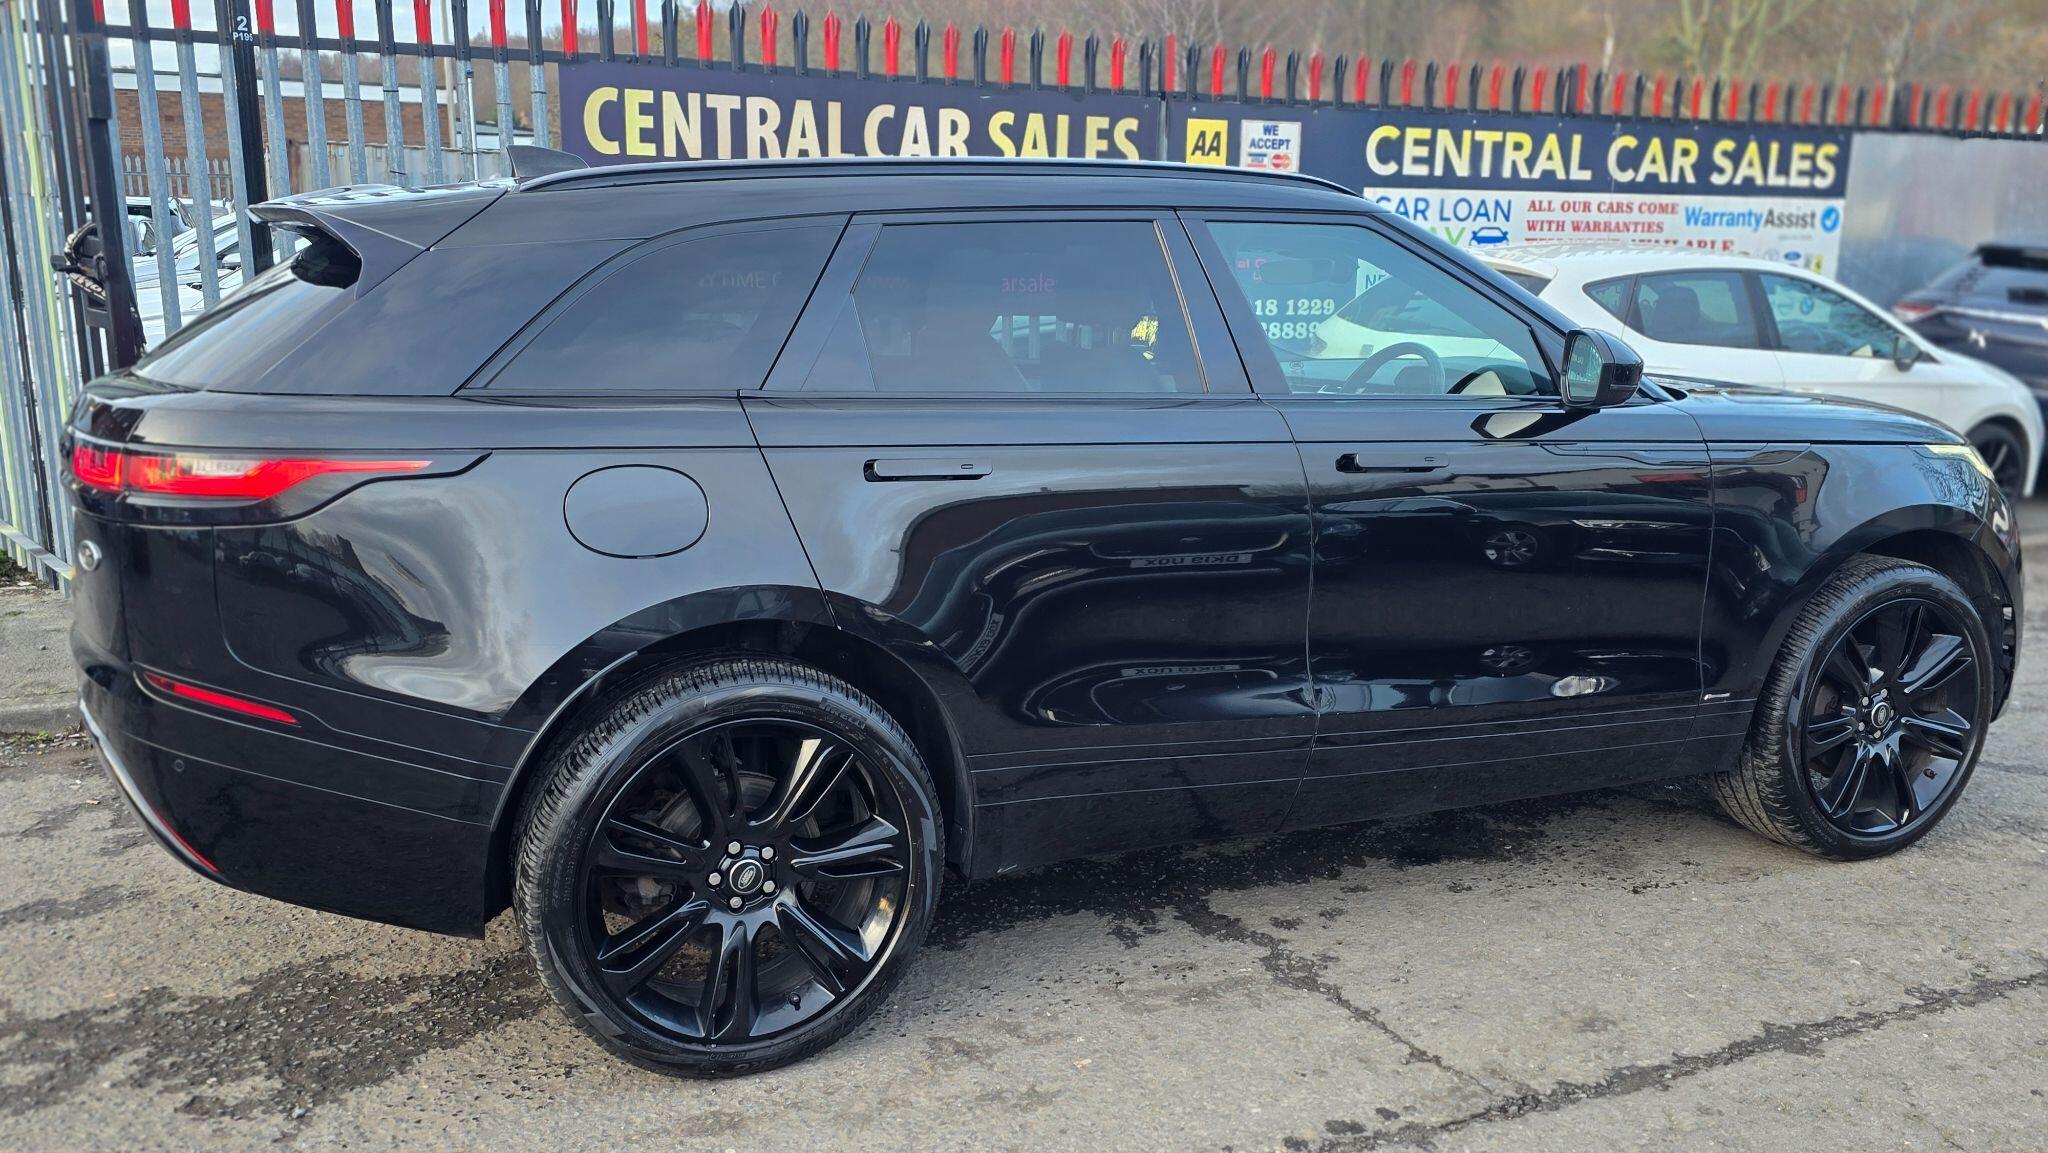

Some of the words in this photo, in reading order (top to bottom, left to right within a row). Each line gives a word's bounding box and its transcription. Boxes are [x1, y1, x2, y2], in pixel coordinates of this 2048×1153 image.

[236, 15, 249, 31] 2
[583, 86, 856, 160] CENTRAL
[863, 103, 971, 157] CAR
[988, 110, 1140, 161] SALES
[1263, 125, 1279, 136] WE
[1190, 130, 1222, 156] AA
[1249, 138, 1291, 150] ACCEPT
[1365, 125, 1593, 181] CENTRAL
[1607, 134, 1699, 186] CAR
[1710, 140, 1840, 190] SALES
[1439, 198, 1512, 222] LOAN
[1527, 200, 1556, 213] ALL
[1560, 200, 1593, 214] OUR
[1597, 201, 1634, 214] CARS
[1637, 202, 1680, 215] COME
[1526, 219, 1566, 233] WITH
[1570, 220, 1665, 235] WARRANTIES
[1285, 298, 1335, 316] 1229
